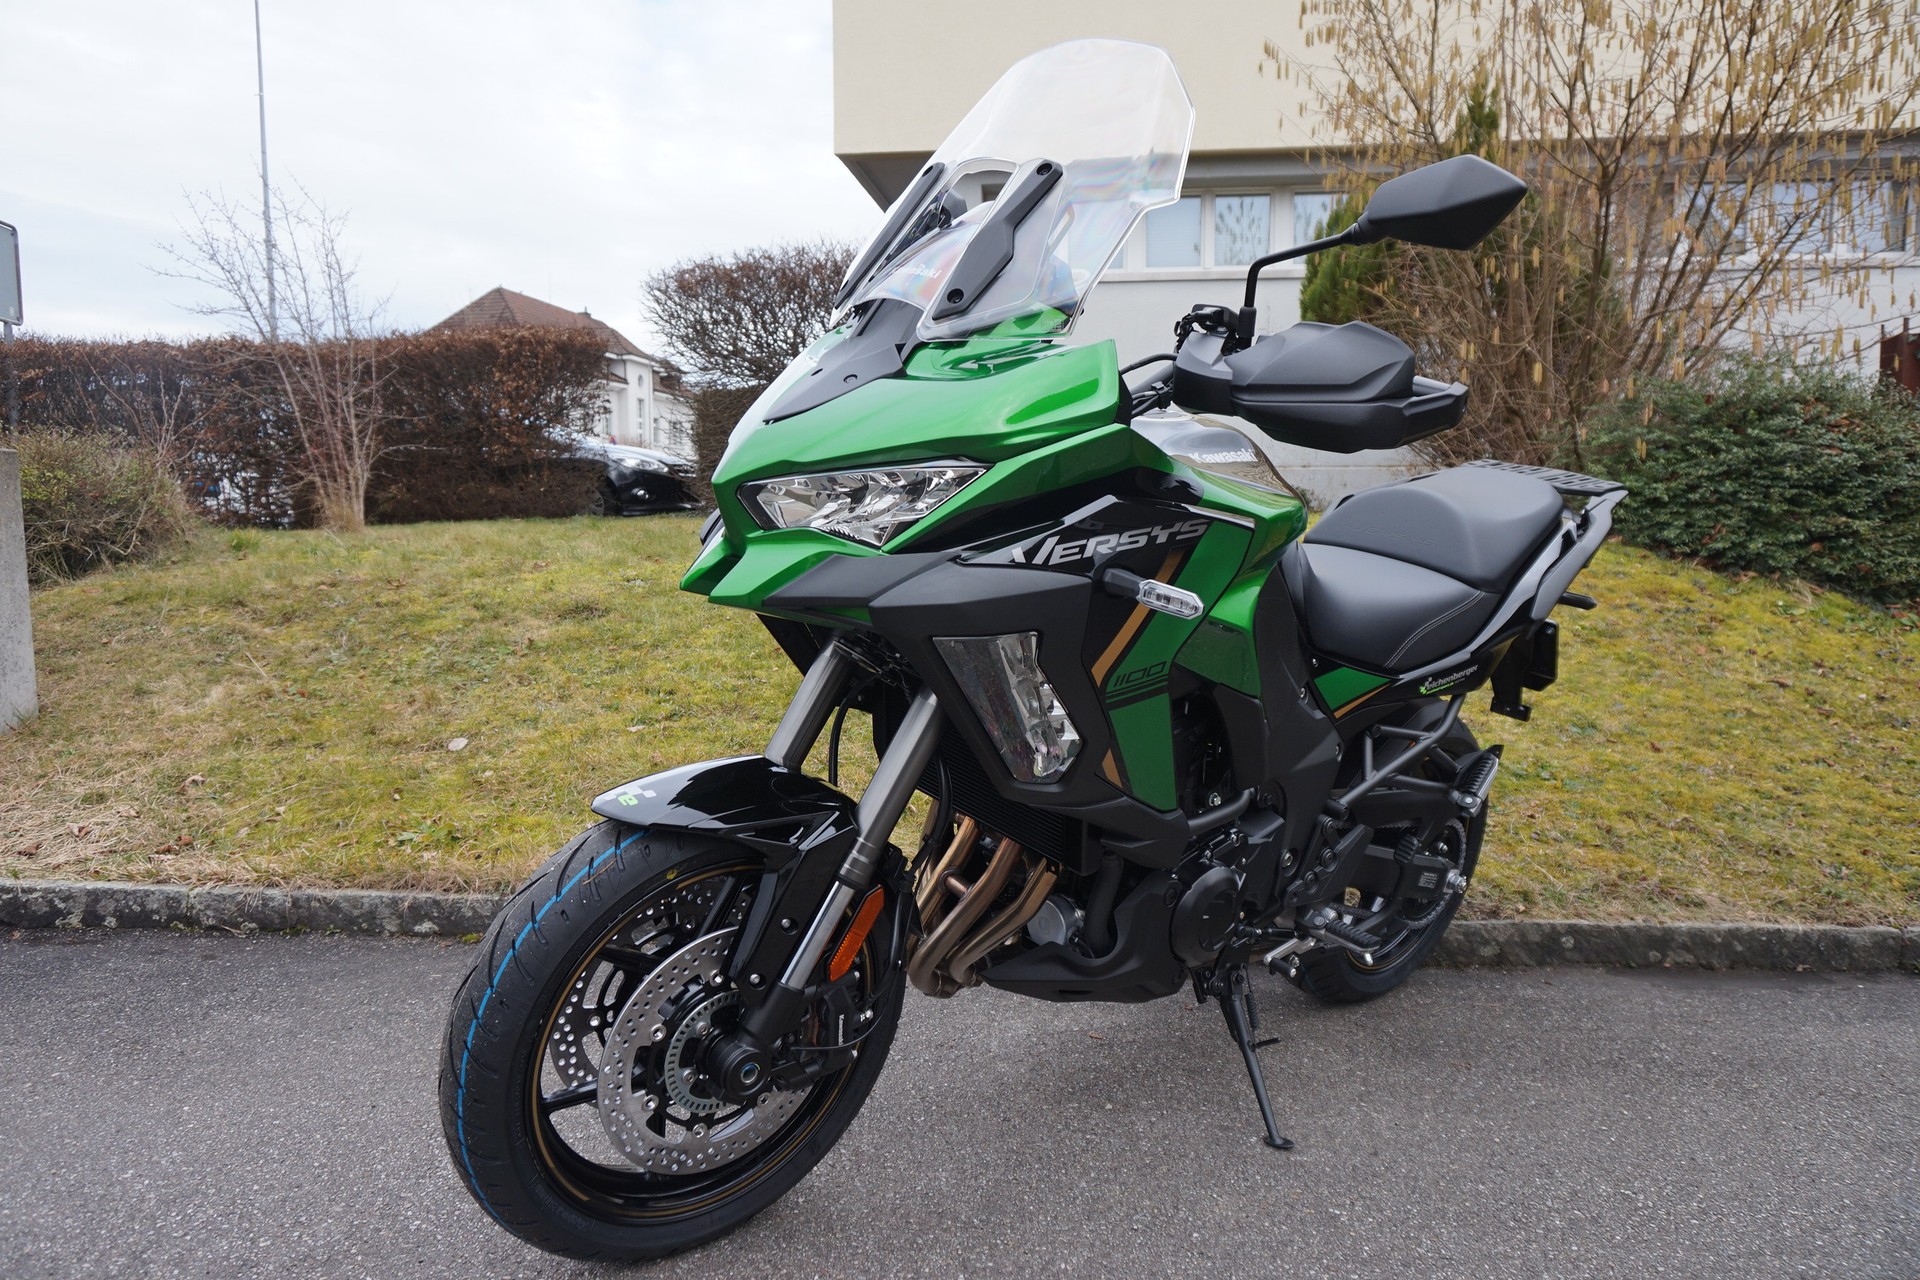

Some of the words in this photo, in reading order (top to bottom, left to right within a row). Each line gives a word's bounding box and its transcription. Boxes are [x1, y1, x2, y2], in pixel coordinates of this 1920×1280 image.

[1189, 448, 1258, 463] Kawasaki
[1011, 519, 1210, 565] VERSYS
[1113, 660, 1167, 688] 1100
